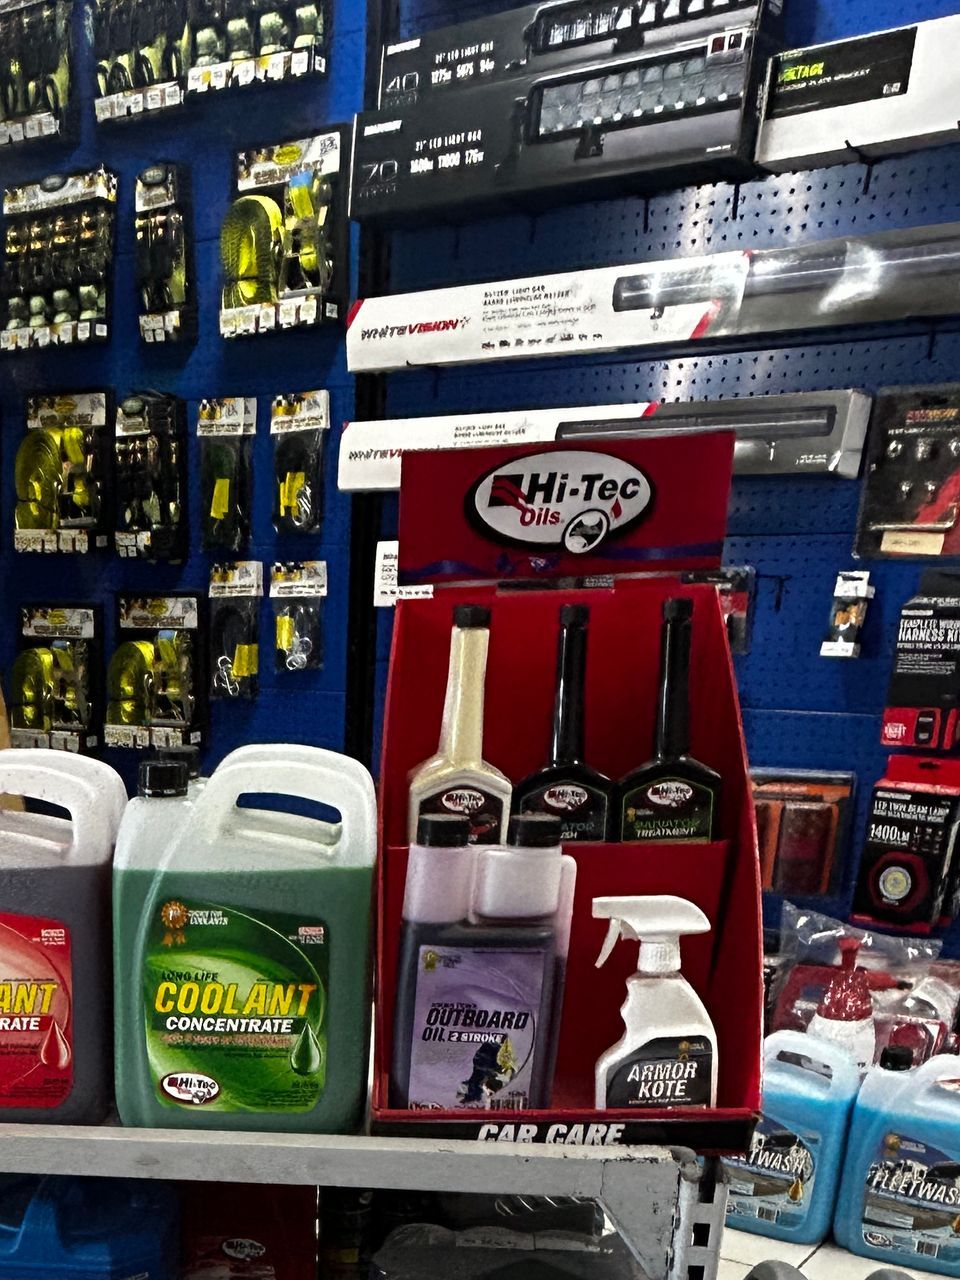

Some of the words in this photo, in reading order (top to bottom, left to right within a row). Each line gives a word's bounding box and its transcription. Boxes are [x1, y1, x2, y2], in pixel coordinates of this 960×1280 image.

[526, 472, 641, 504] Hi-Tec
[520, 507, 561, 527] Oils
[161, 970, 192, 981] LONG
[195, 970, 219, 982] LIFE
[154, 981, 317, 1017] COOLANT
[166, 1016, 294, 1033] CONCENTRATE
[426, 1008, 530, 1029] OUTBOARD
[422, 1026, 446, 1042] OIL
[460, 1033, 504, 1044] STROKE
[627, 1061, 698, 1082] ARMOR
[638, 1080, 688, 1098] KOTE
[478, 1124, 538, 1144] CAR
[546, 1124, 626, 1145] CARE
[871, 1168, 960, 1205] FLEETWAS
